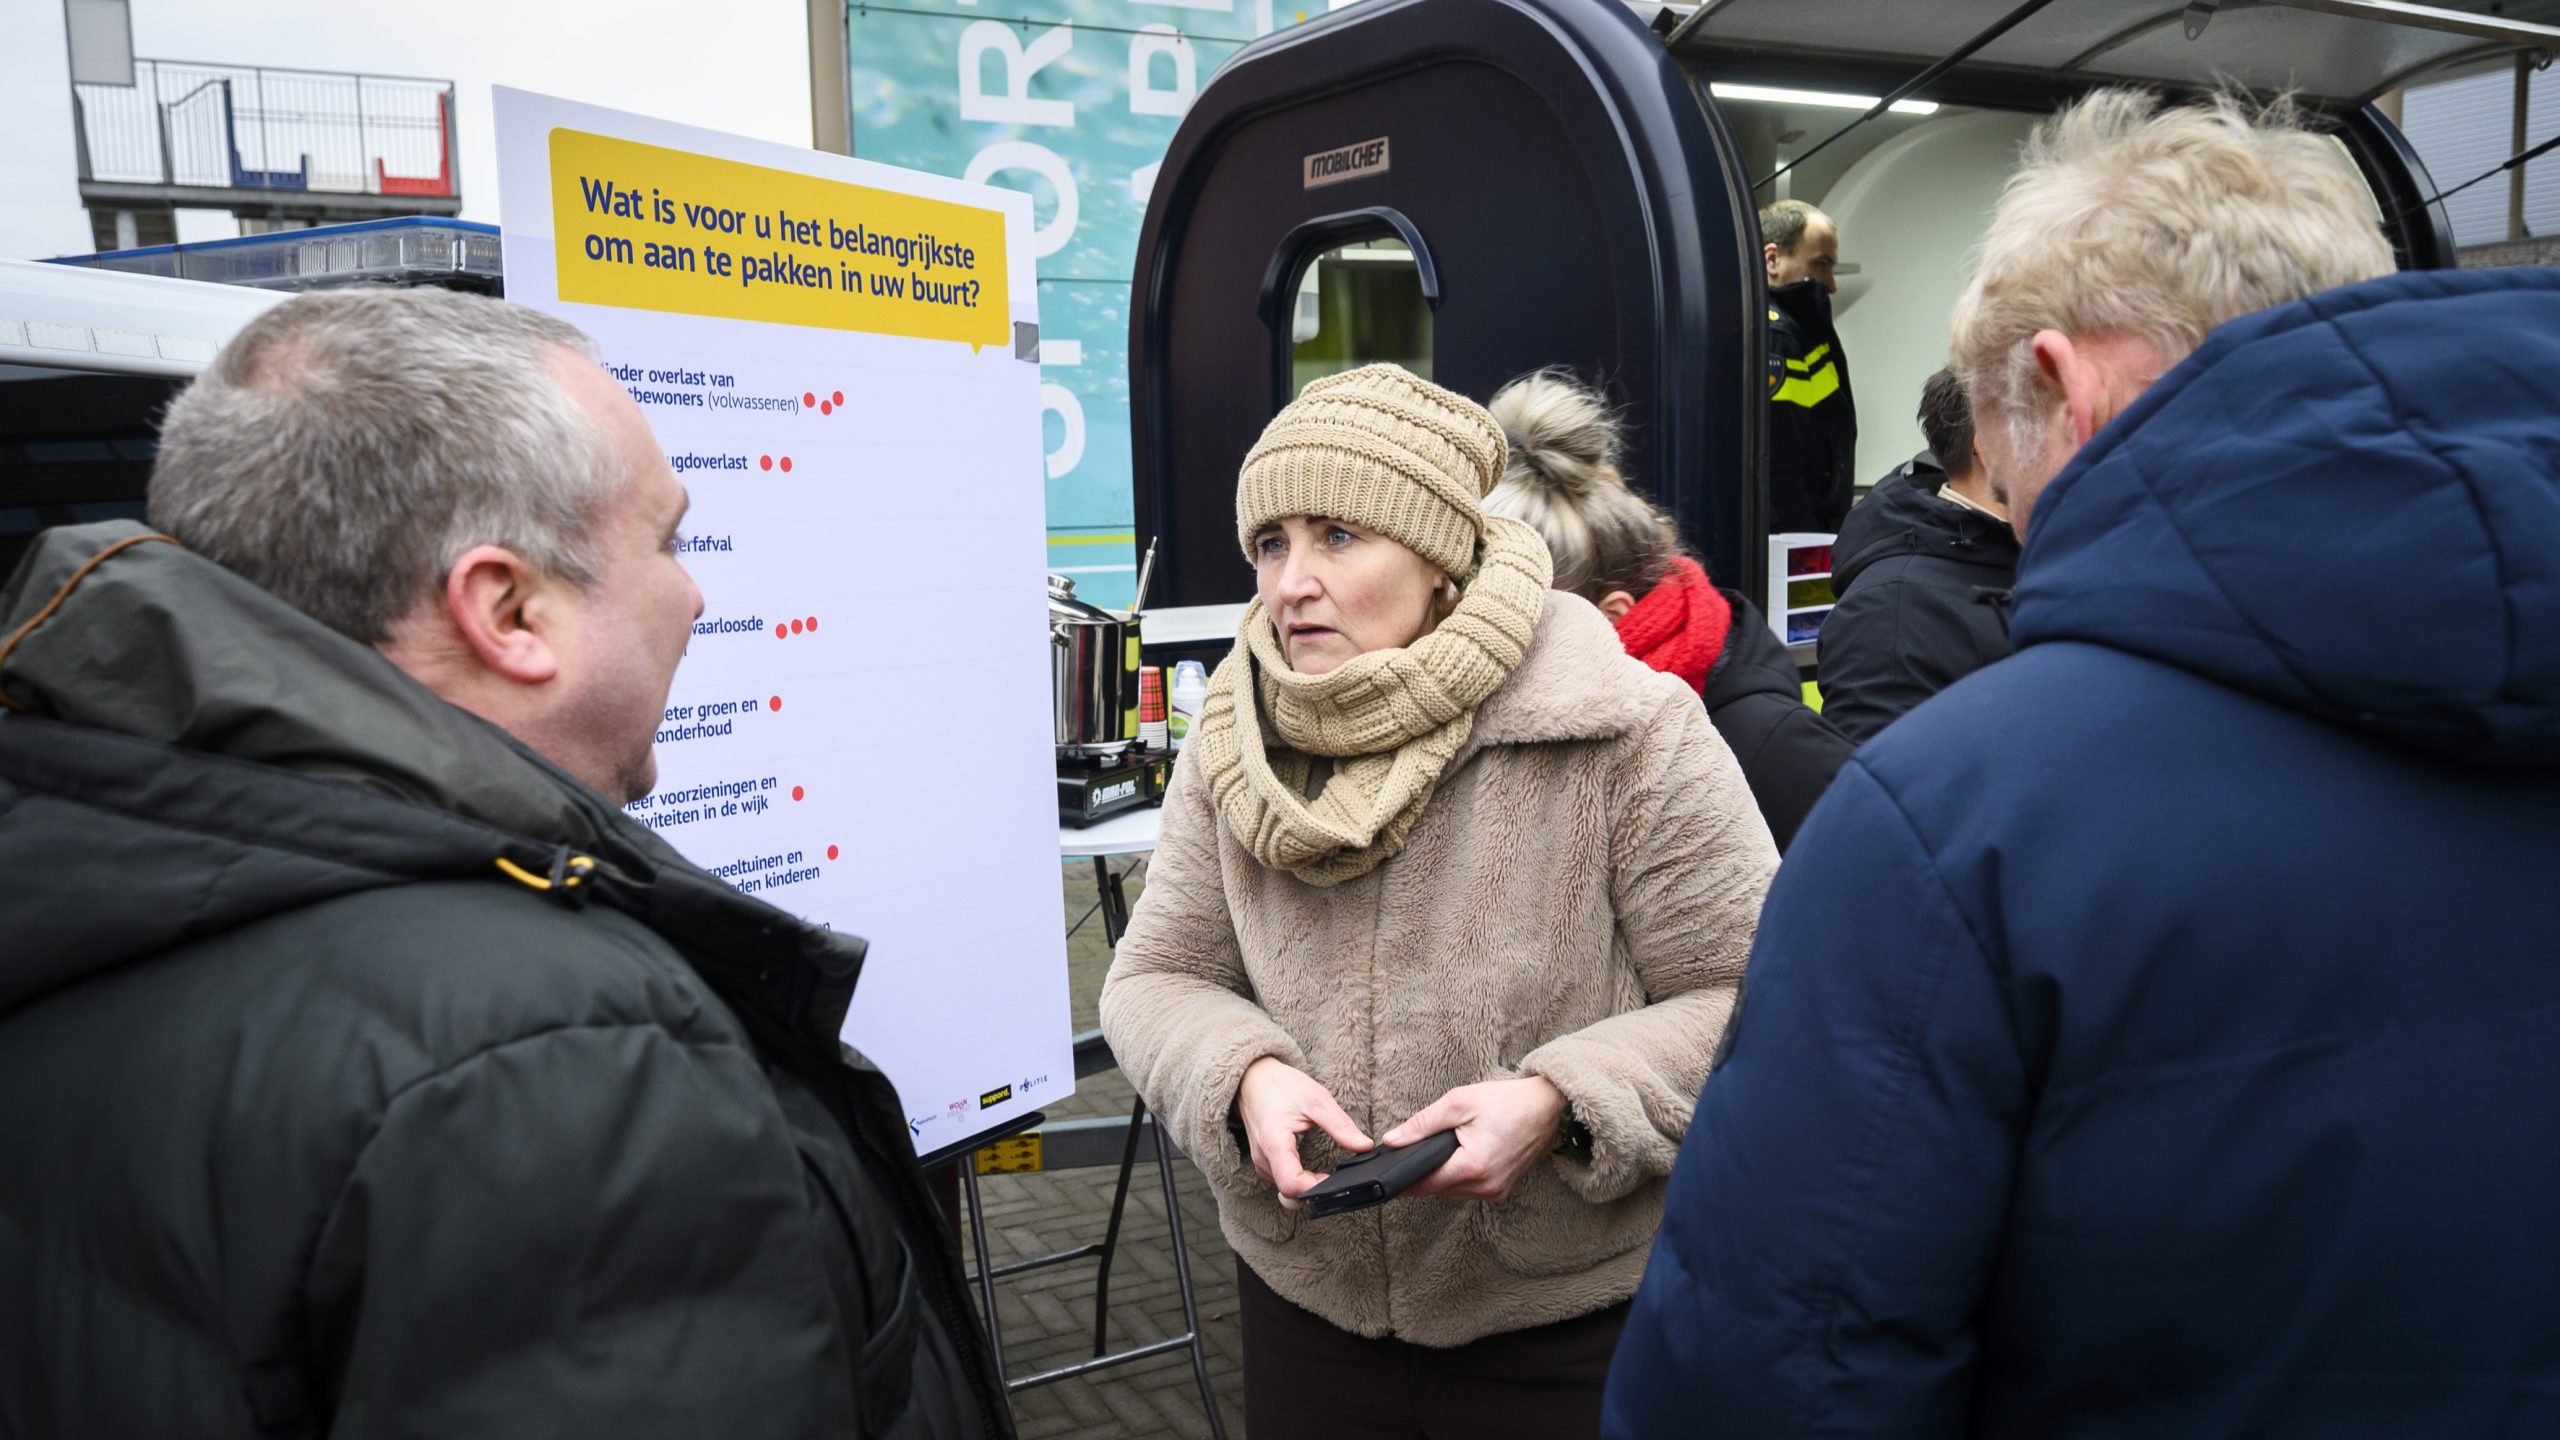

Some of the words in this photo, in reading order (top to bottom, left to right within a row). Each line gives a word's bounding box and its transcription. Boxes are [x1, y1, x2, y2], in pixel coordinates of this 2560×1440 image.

[1311, 141, 1385, 179] MOBILCHEF
[580, 176, 644, 220] Wat
[653, 188, 676, 224] is
[683, 203, 746, 234] voor
[755, 214, 771, 239] u
[779, 210, 822, 247] het
[829, 218, 975, 270] belangrijkste
[585, 234, 633, 264] om
[644, 242, 696, 272] aan
[704, 246, 732, 277] te
[742, 252, 833, 290] pakken
[840, 261, 862, 293] in
[871, 273, 904, 298] uw
[912, 272, 980, 308] buurt?
[600, 362, 643, 382] inder
[649, 367, 706, 387] overlast
[710, 373, 734, 388] van
[708, 391, 799, 416] (volwassenen)
[698, 701, 737, 722] groen
[742, 699, 758, 712] en
[652, 719, 733, 744] onderhoud
[659, 779, 757, 806] voorzieningen
[761, 776, 777, 790] en
[704, 804, 717, 820] in
[721, 800, 737, 816] de
[741, 795, 769, 815] wijk
[787, 850, 802, 864] en
[765, 866, 820, 889] kinderen
